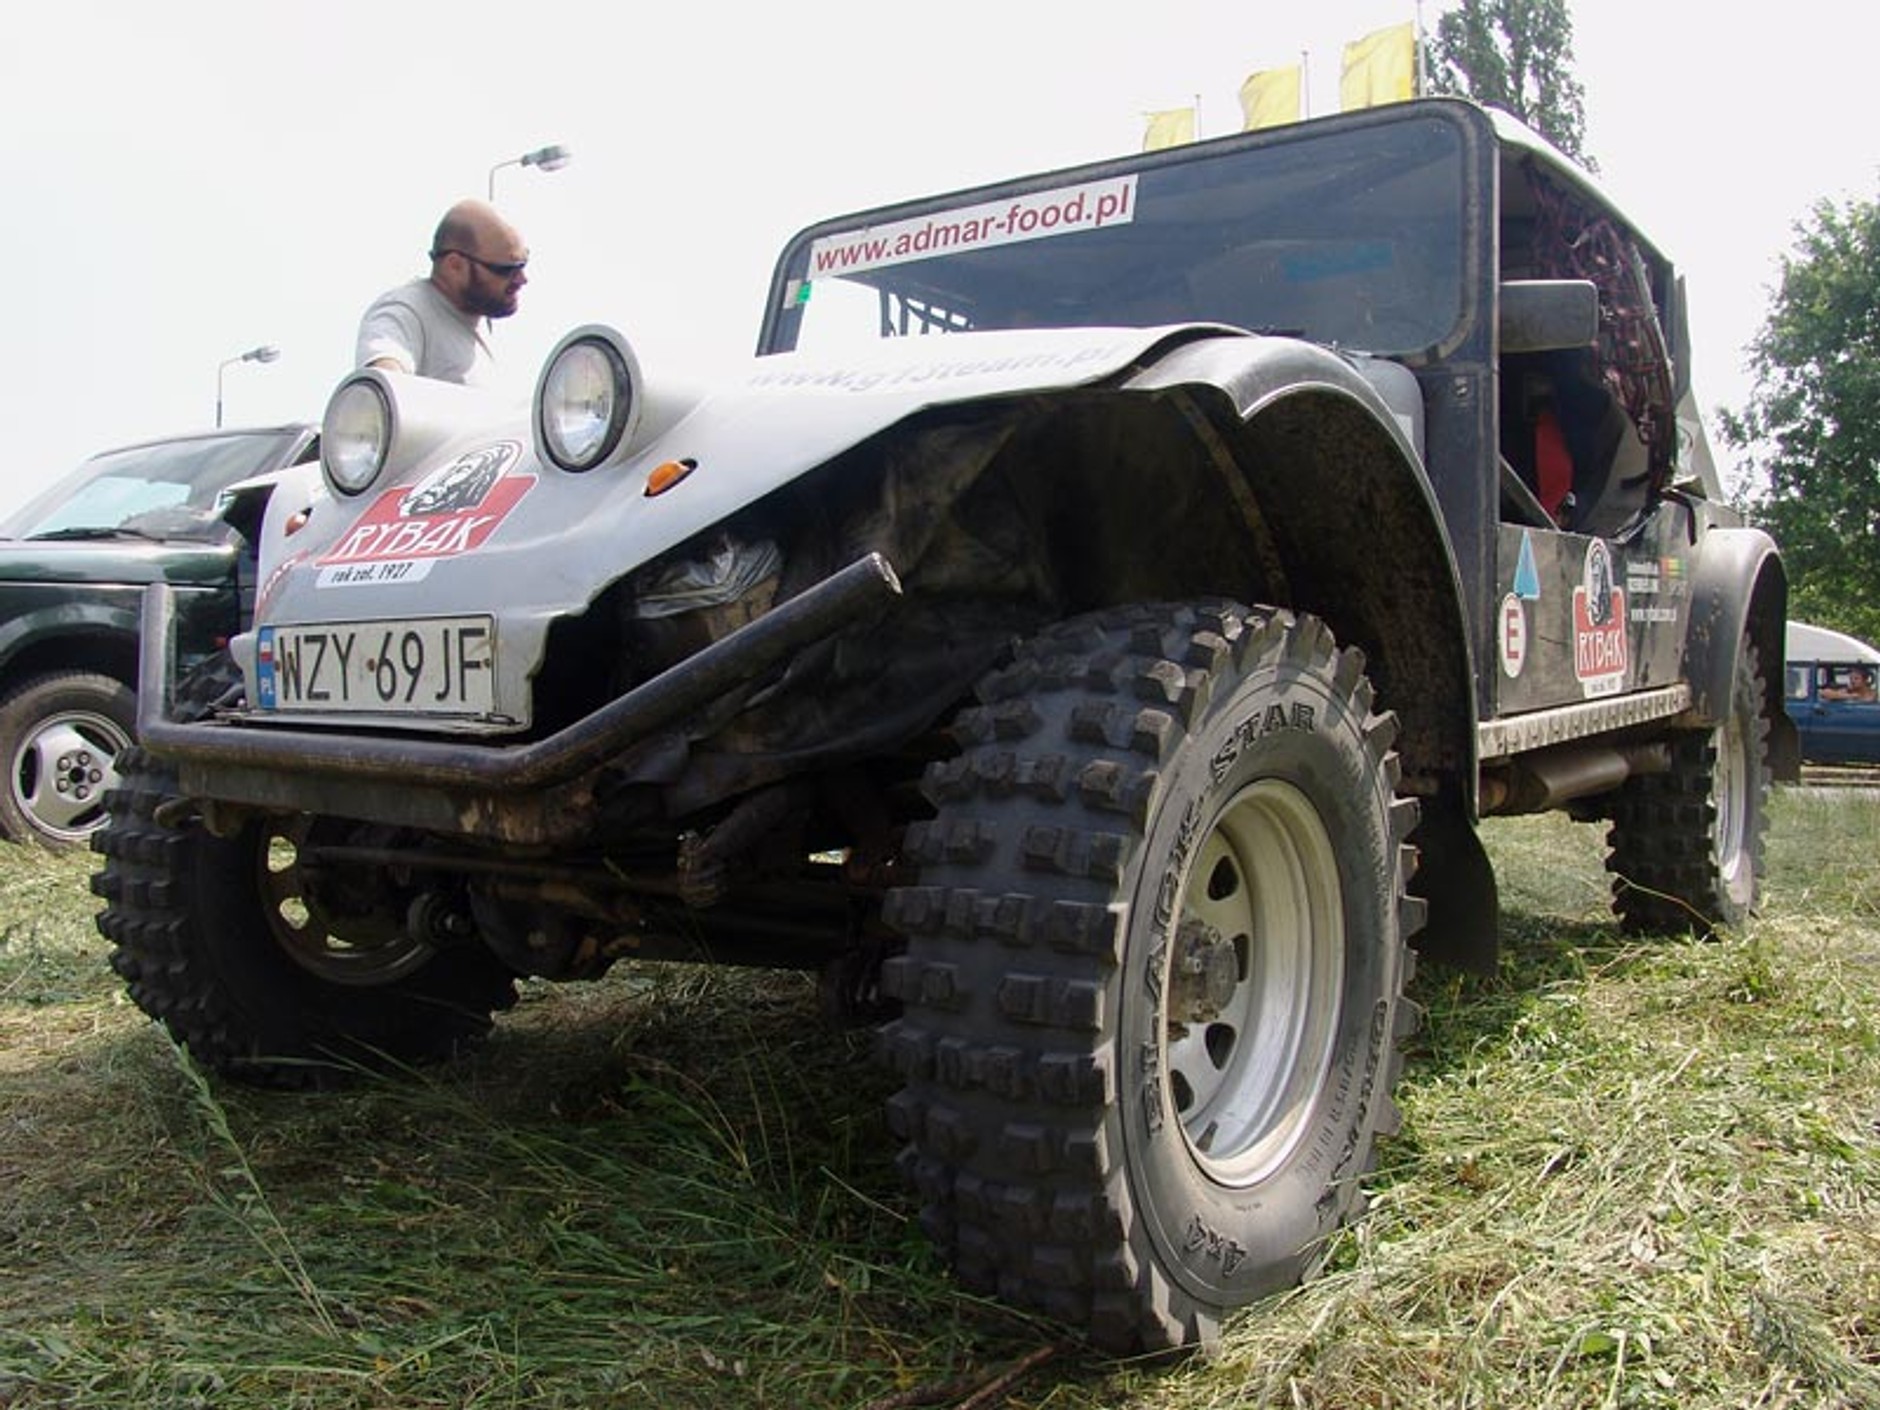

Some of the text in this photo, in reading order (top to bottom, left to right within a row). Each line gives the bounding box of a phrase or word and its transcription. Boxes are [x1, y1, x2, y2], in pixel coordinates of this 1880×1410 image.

[815, 184, 1130, 272] www.admar-food.pl
[330, 515, 496, 560] RYBAK
[1506, 609, 1519, 659] E
[1579, 630, 1624, 672] RYBAK
[260, 677, 273, 695] PL
[279, 632, 355, 701] WZY
